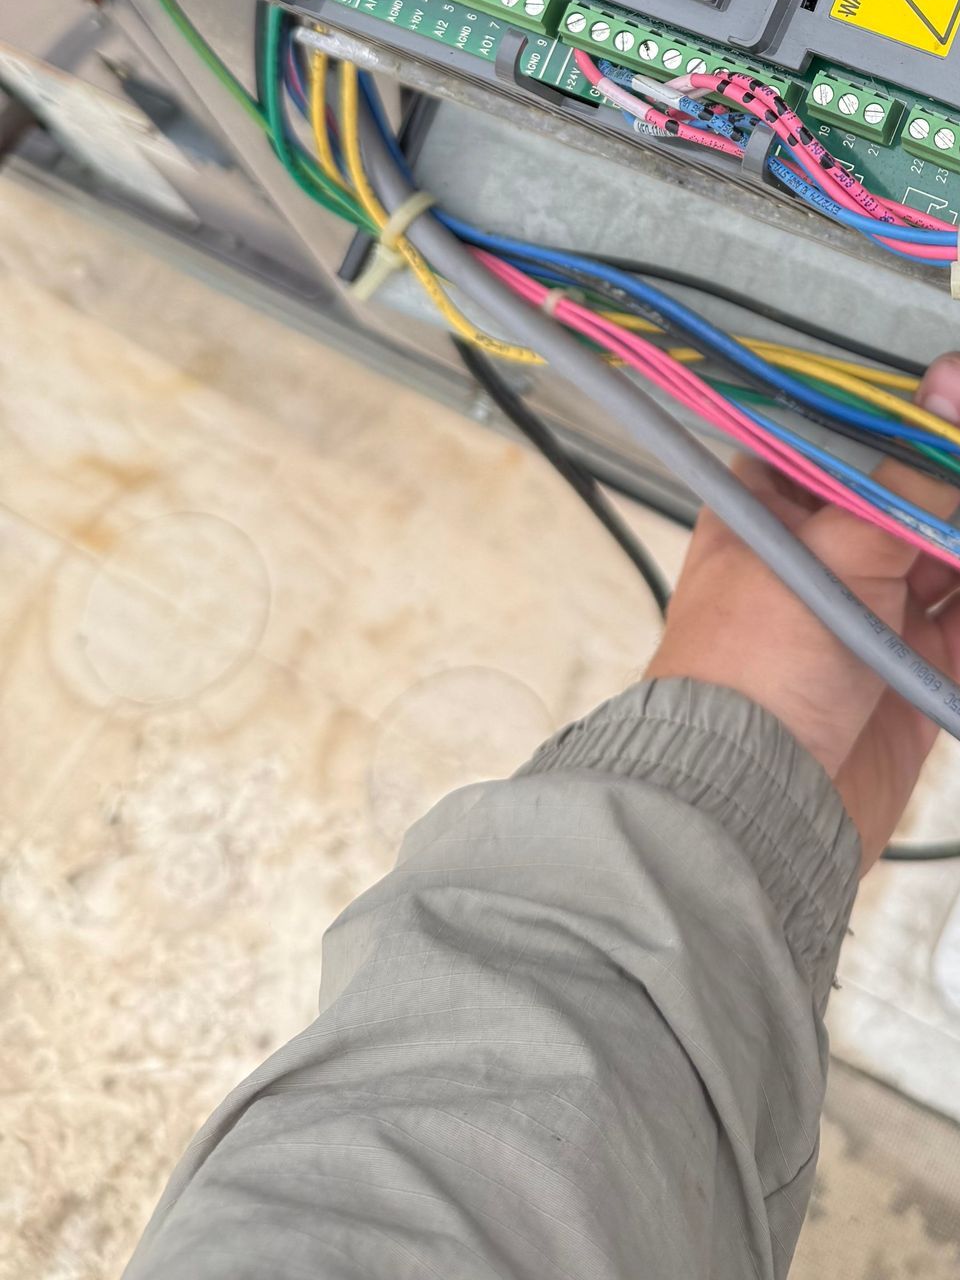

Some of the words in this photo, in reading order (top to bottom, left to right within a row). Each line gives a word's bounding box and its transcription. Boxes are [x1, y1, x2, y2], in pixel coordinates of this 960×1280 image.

[387, 0, 403, 23] AGND
[443, 4, 455, 12] 5
[410, 9, 425, 31] +10V
[489, 21, 500, 30] 7
[456, 25, 472, 49] AGND
[466, 13, 478, 21] 6
[525, 52, 541, 75] AGND
[566, 67, 581, 90] +24V
[818, 125, 831, 136] 19
[843, 134, 856, 149] 20
[911, 159, 925, 174] 22
[935, 168, 949, 184] 23
[910, 660, 944, 691] 600V
